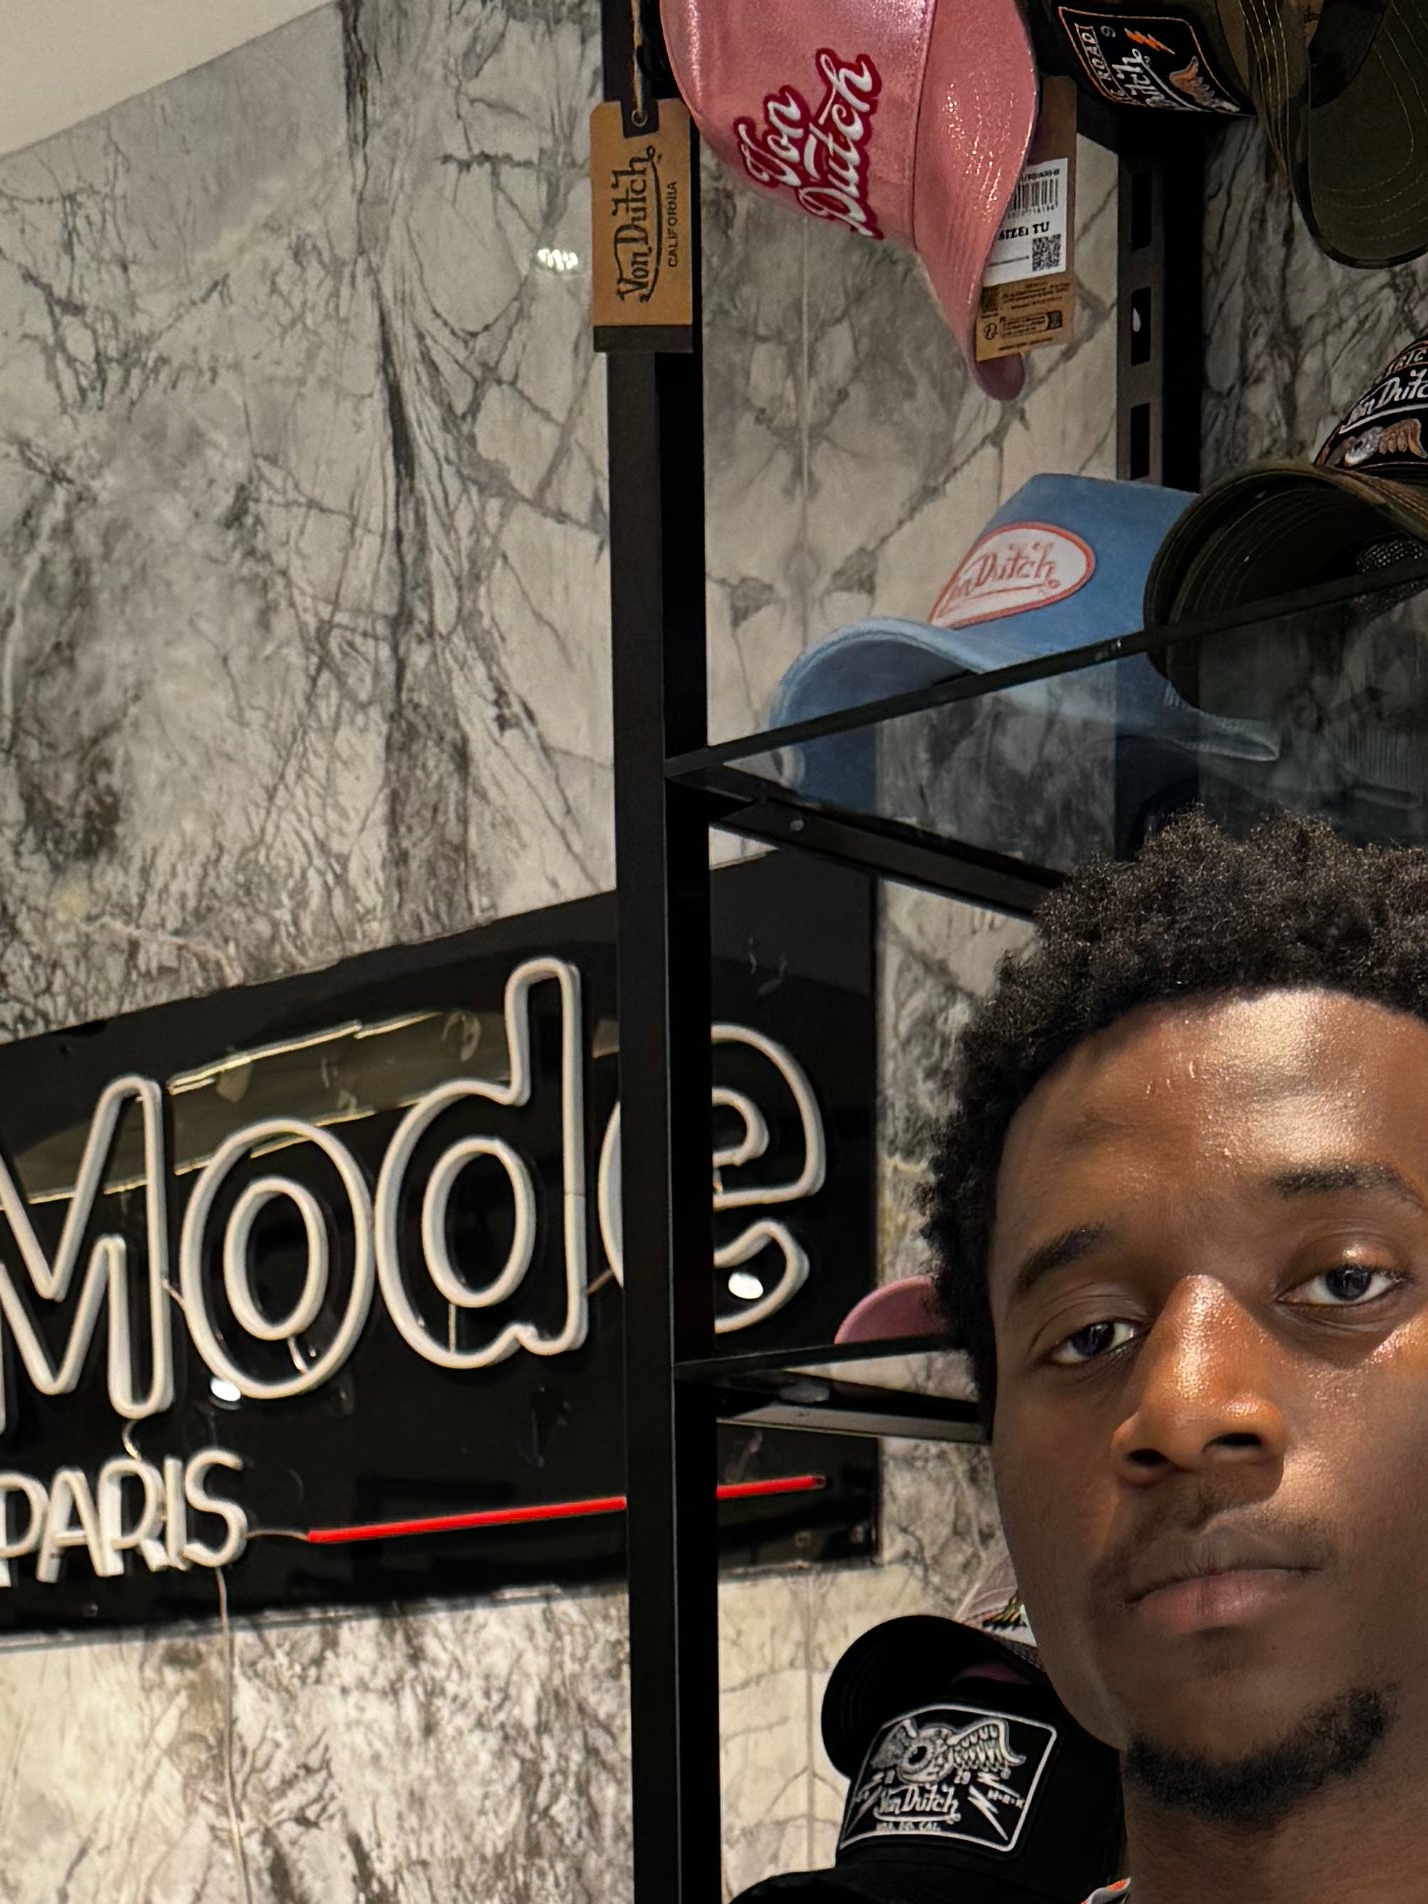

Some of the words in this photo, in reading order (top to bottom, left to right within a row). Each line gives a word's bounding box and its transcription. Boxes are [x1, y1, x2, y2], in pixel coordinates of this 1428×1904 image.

[798, 50, 880, 239] Dutch
[610, 146, 657, 247] Dutch
[664, 181, 679, 268] CALIFORNIA
[1032, 220, 1051, 235] TU
[615, 246, 653, 304] Von
[900, 1784, 960, 1816] Dutch
